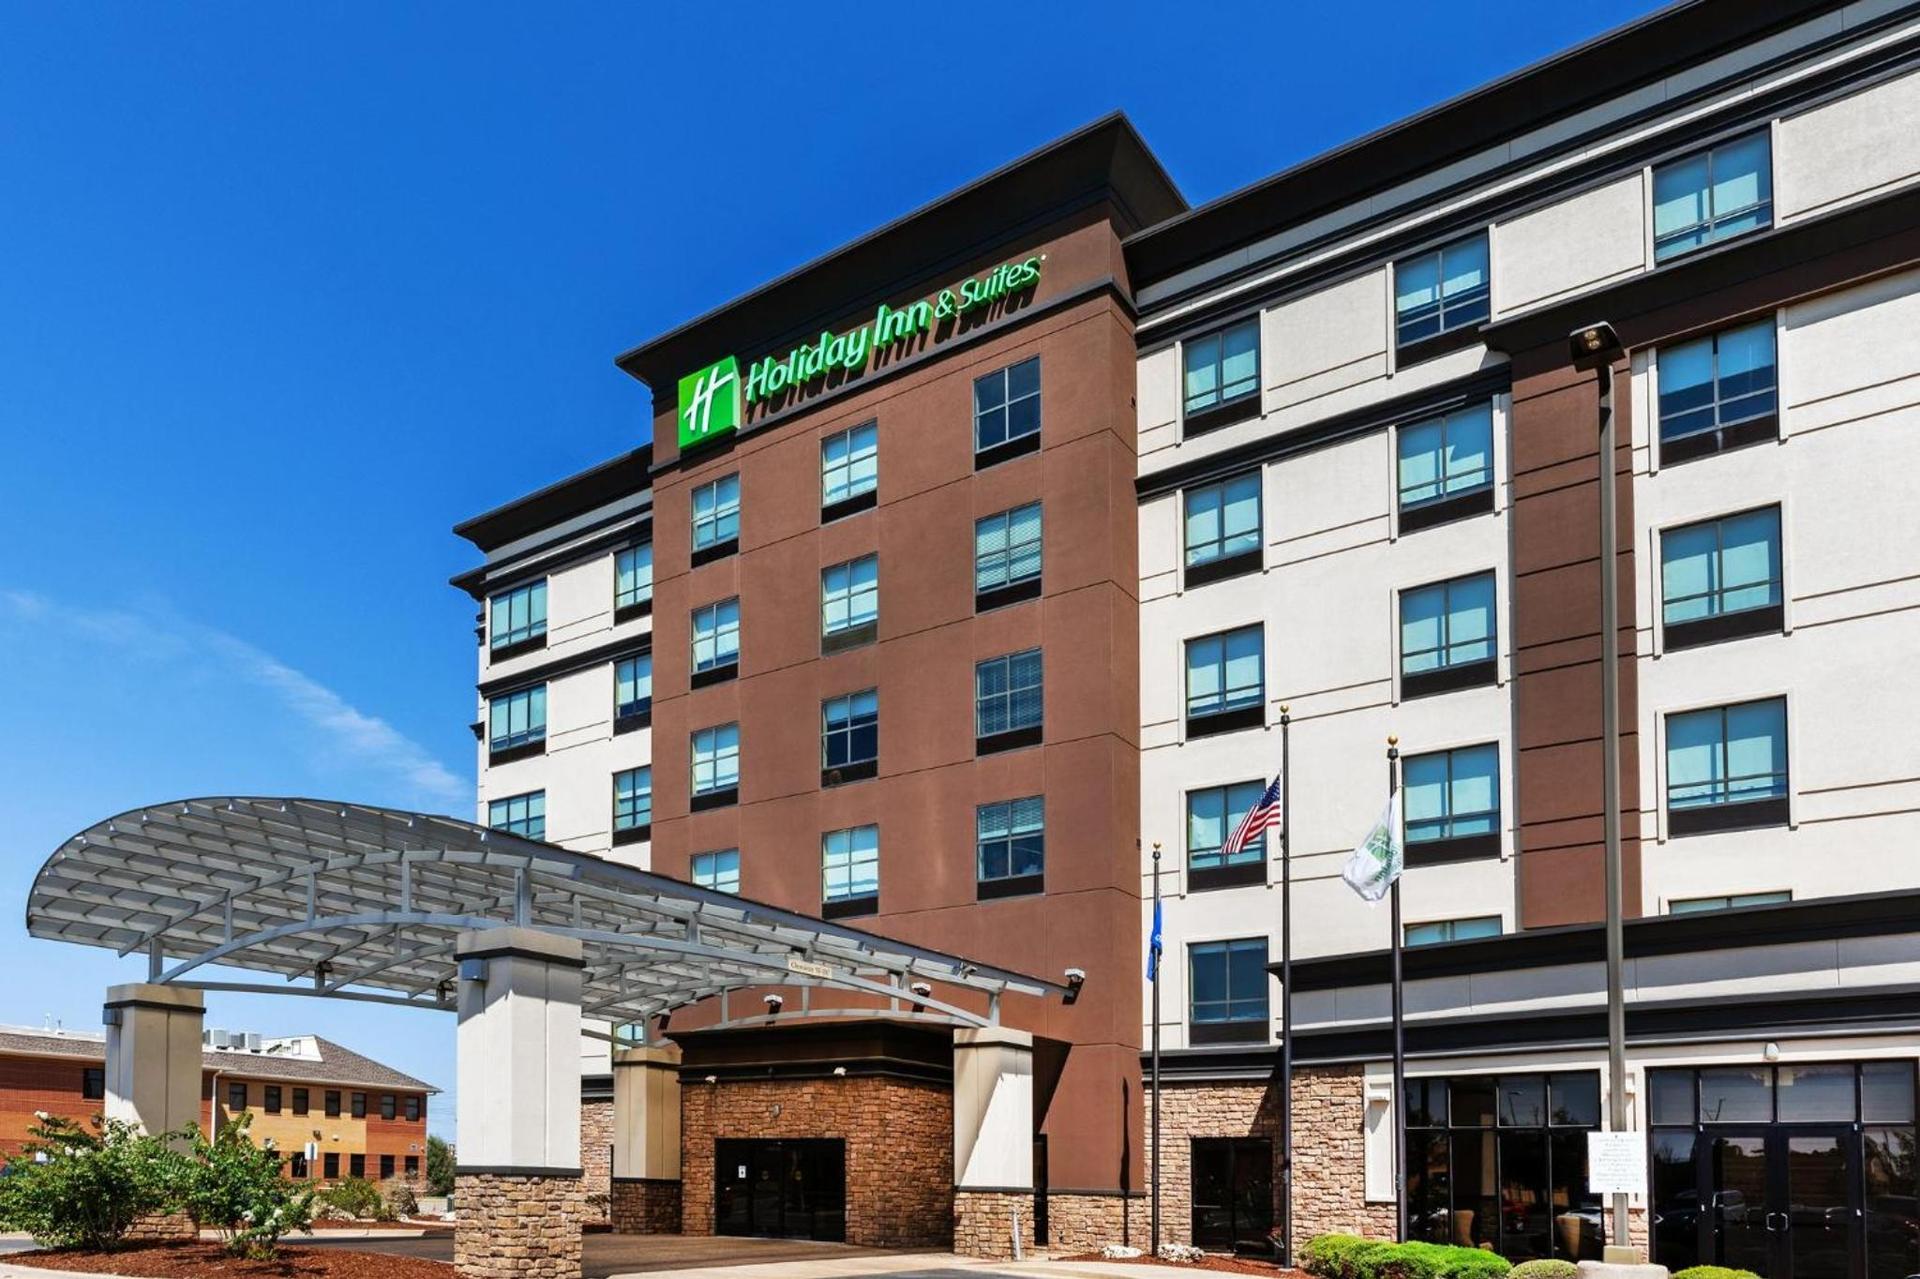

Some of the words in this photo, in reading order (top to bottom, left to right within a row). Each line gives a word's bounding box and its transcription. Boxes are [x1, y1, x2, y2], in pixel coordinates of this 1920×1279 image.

[744, 327, 870, 402] Holiday
[873, 301, 933, 348] Inn
[934, 289, 959, 319] &
[957, 256, 1042, 311] Suites
